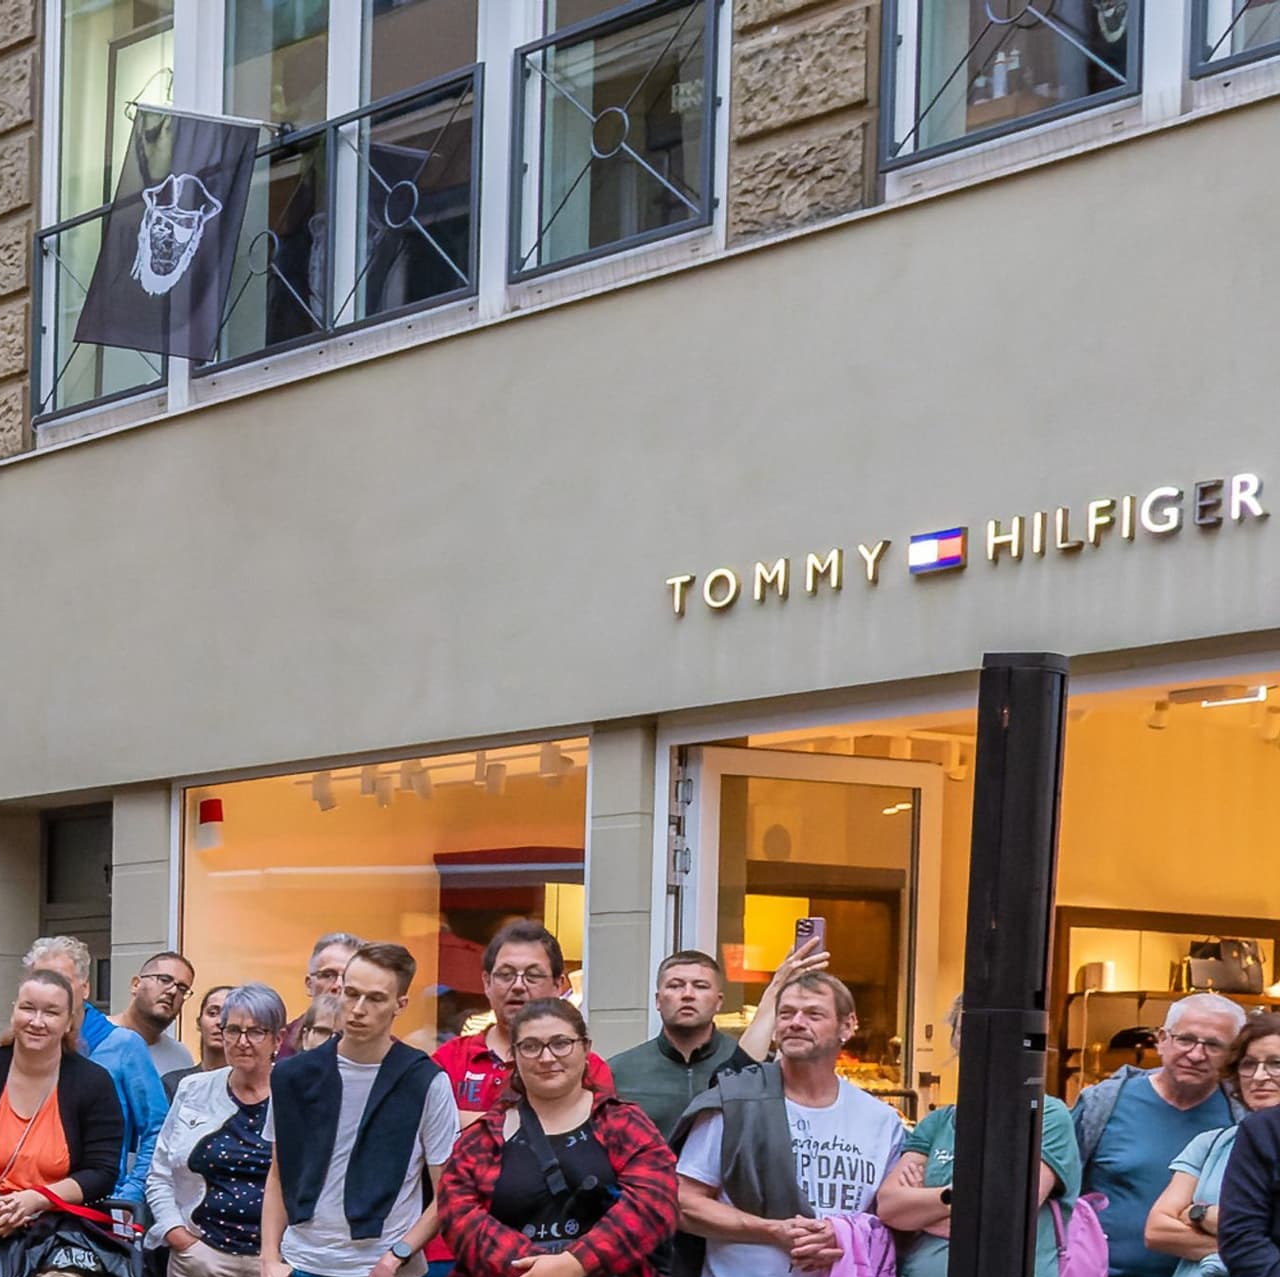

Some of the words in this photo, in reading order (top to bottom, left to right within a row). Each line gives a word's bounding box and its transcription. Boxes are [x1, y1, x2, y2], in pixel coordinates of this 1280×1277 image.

[665, 539, 890, 616] TOMMY
[986, 472, 1269, 563] HILFIGER
[791, 1135, 862, 1159] avigation
[818, 1155, 876, 1185] DAVID
